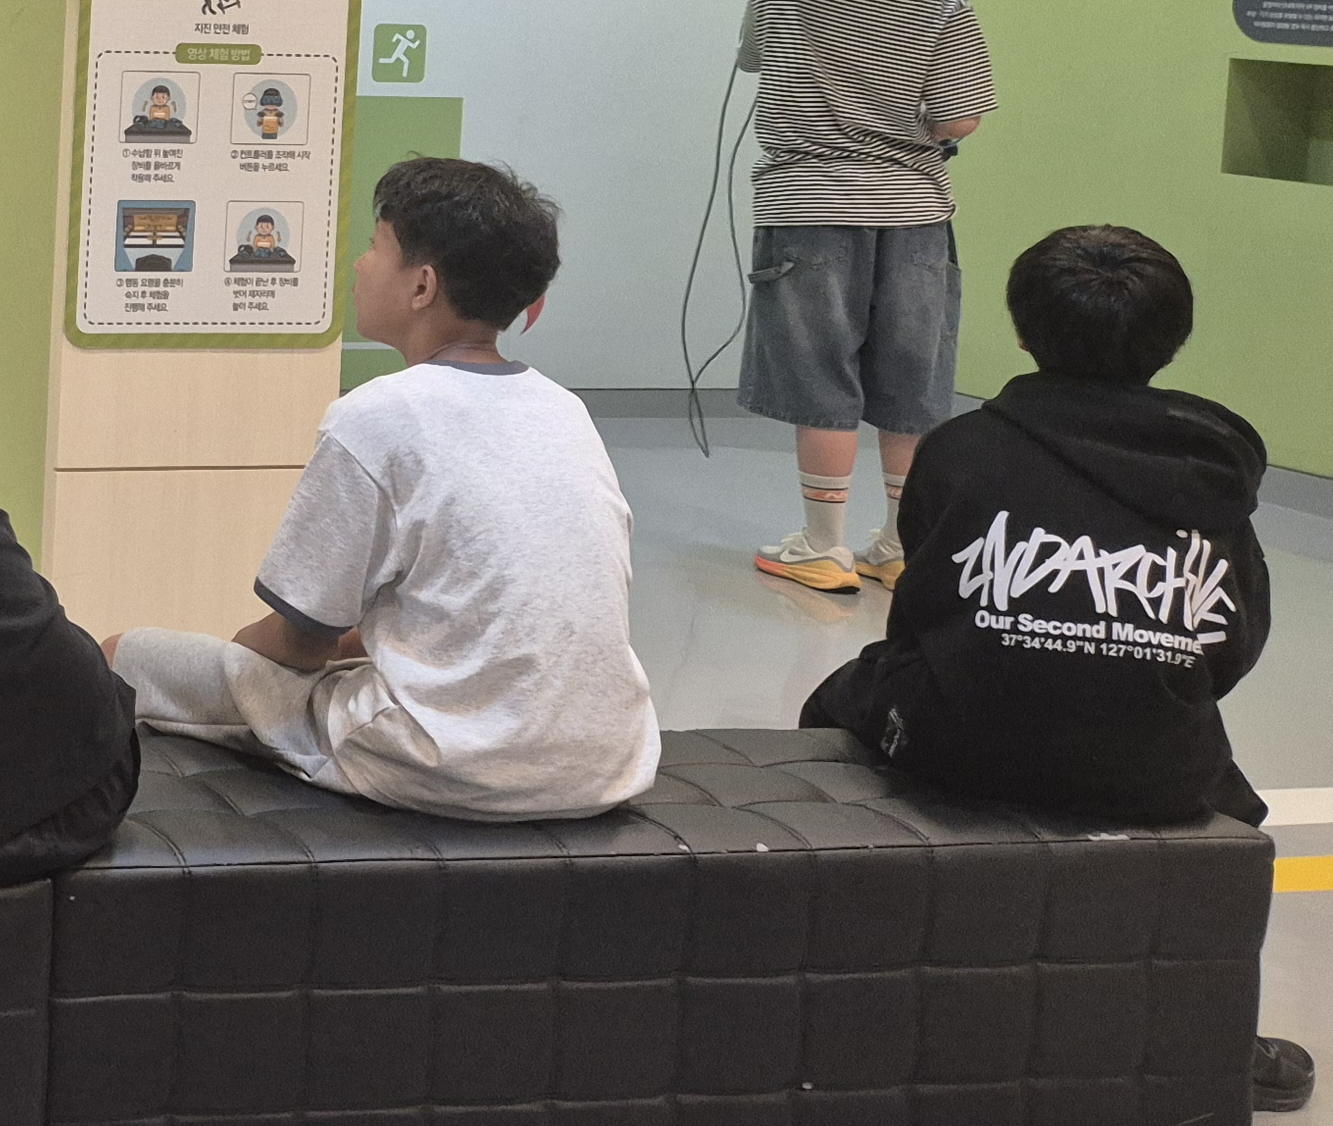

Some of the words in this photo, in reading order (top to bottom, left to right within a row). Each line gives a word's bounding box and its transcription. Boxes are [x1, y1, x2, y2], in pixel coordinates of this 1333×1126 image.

[194, 23, 211, 34] 지진
[213, 23, 231, 35] 안전
[232, 23, 250, 35] 체험
[187, 47, 207, 61] 영상
[209, 48, 229, 61] 체험
[231, 49, 251, 61] 방법
[975, 609, 1015, 631] Our
[1017, 613, 1106, 640] Second
